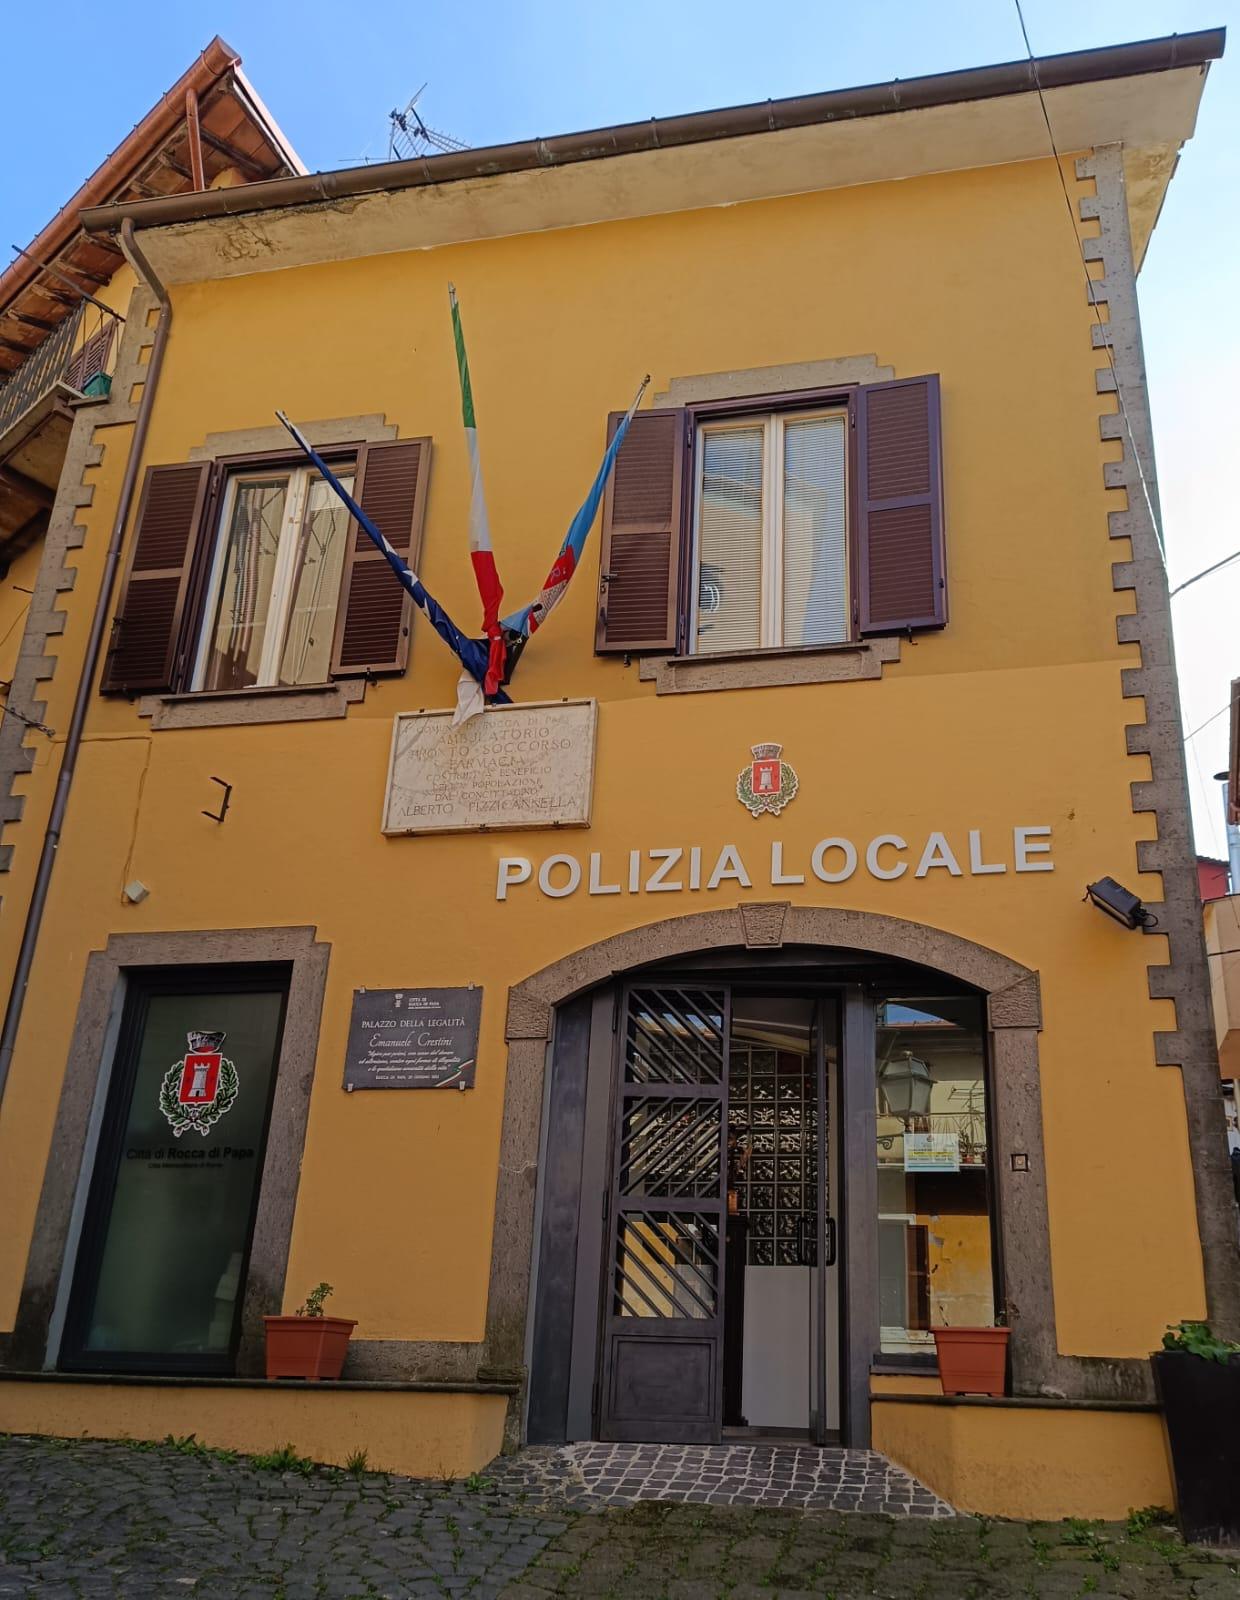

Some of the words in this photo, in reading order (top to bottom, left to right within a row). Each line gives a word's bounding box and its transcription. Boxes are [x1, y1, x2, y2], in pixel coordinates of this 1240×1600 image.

[527, 716, 538, 726] DI
[438, 727, 551, 746] AMBULATORIO
[409, 745, 470, 762] PRONTO
[482, 738, 572, 756] SOCCORSO
[449, 755, 526, 770] FARMACIA
[499, 766, 552, 777] BENEFICIO
[398, 803, 454, 817] ALBERTO
[496, 844, 752, 899] POLIZIA
[770, 826, 1055, 885] LOCALE
[362, 1020, 396, 1028] PALAZZO
[400, 1020, 424, 1028] DELLA
[428, 1017, 465, 1027] LEGALITÀ
[369, 1031, 415, 1047] Emanuele
[417, 1032, 454, 1047] Crestini
[155, 1147, 164, 1159] di
[167, 1147, 205, 1159] Rocca
[208, 1146, 220, 1159] di
[223, 1146, 255, 1160] Papa
